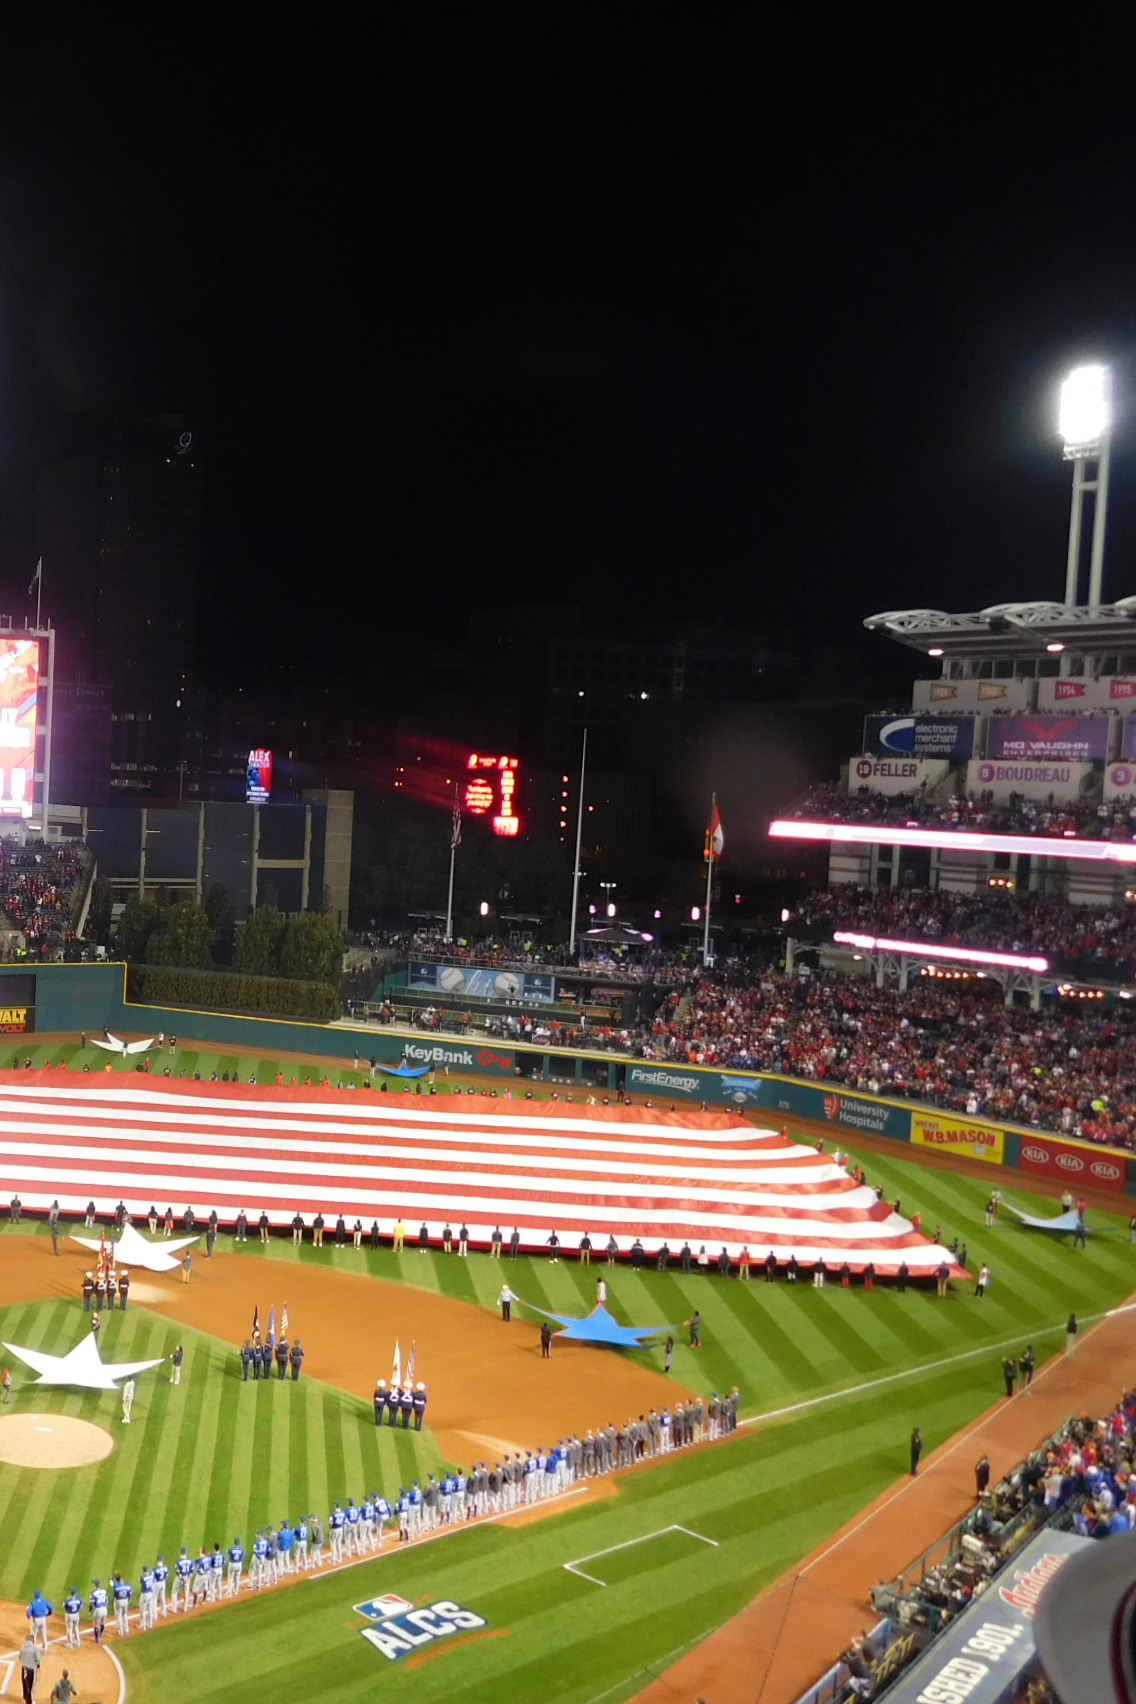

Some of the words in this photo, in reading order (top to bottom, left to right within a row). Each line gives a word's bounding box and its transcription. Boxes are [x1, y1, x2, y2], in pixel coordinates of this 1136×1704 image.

[915, 723, 958, 733] electronic
[915, 733, 957, 743] merchant
[1029, 741, 1088, 749] VAUGHN
[248, 750, 270, 761] ALEX
[915, 744, 953, 752] systems
[873, 763, 917, 777] FELLER
[996, 766, 1070, 782] BOUDREAU
[404, 1044, 473, 1065] KeyBank
[631, 1069, 699, 1090] FirstEnergy
[840, 1099, 889, 1121] University
[839, 1111, 884, 1130] Hospitals
[360, 1601, 486, 1660] ALCS
